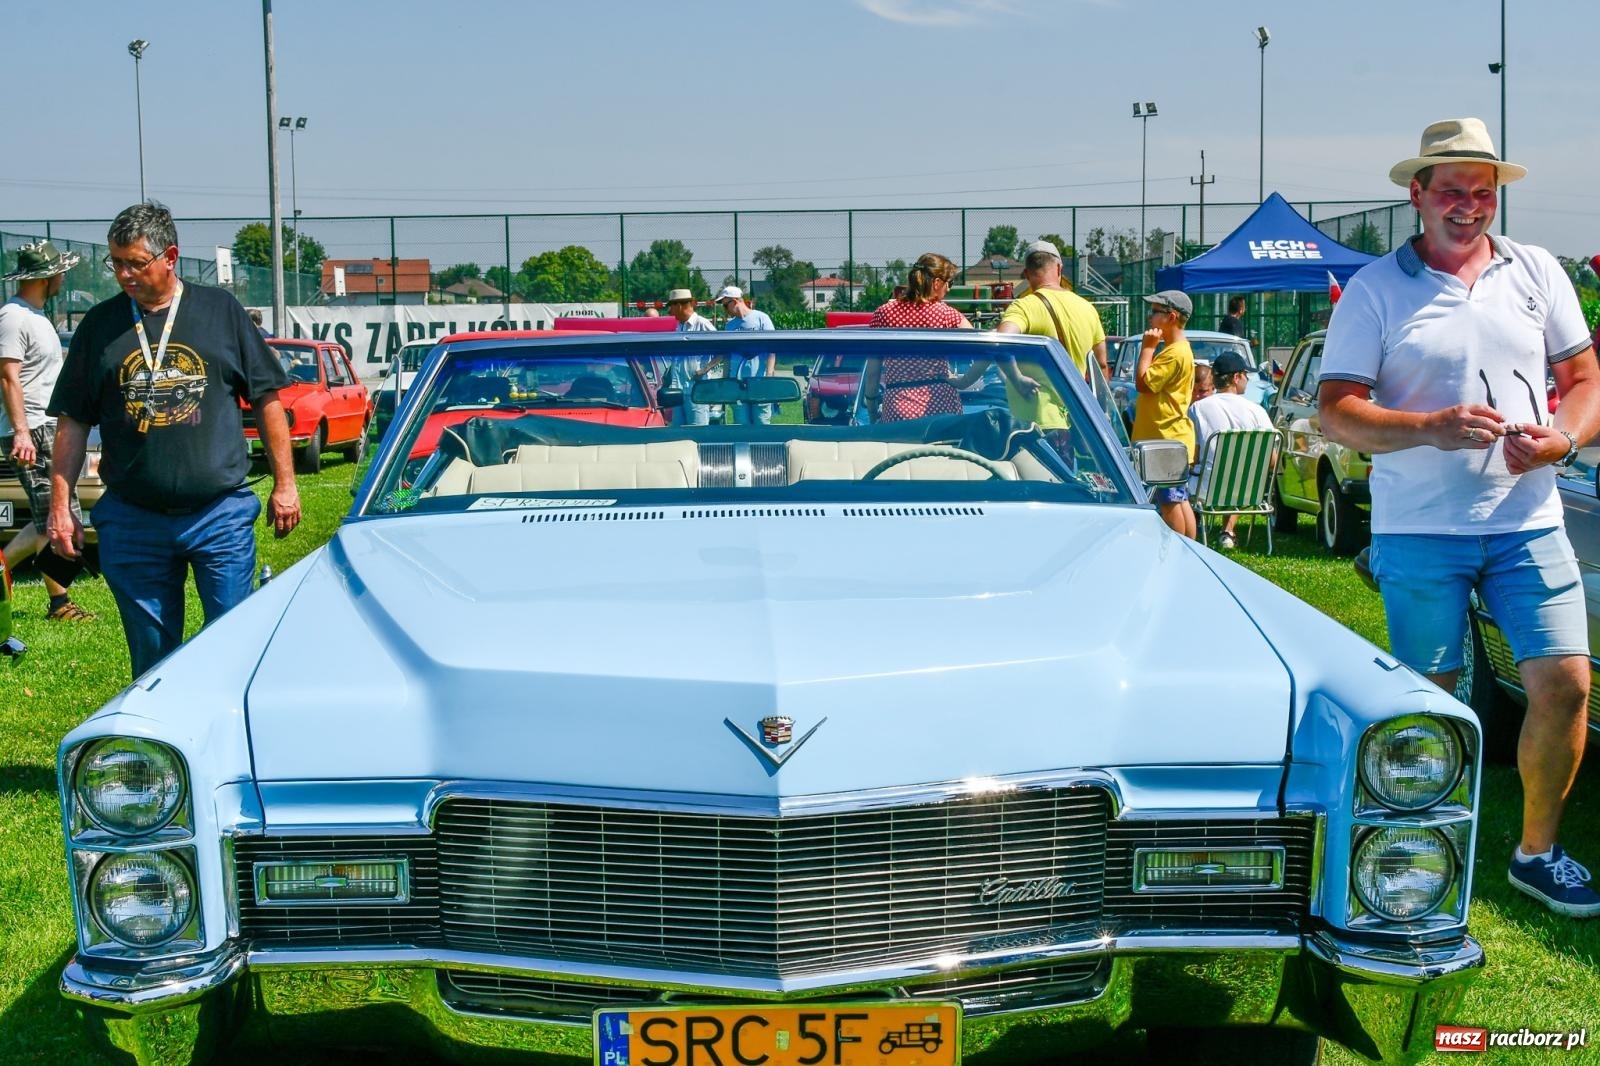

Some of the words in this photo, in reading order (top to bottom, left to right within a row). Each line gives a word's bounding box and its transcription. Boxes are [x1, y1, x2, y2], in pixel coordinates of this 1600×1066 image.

[1248, 240, 1306, 251] LECH
[1251, 250, 1324, 260] FREE
[980, 877, 1077, 905] Cadillac
[640, 1015, 771, 1066] SRC
[797, 1013, 869, 1065] 5F
